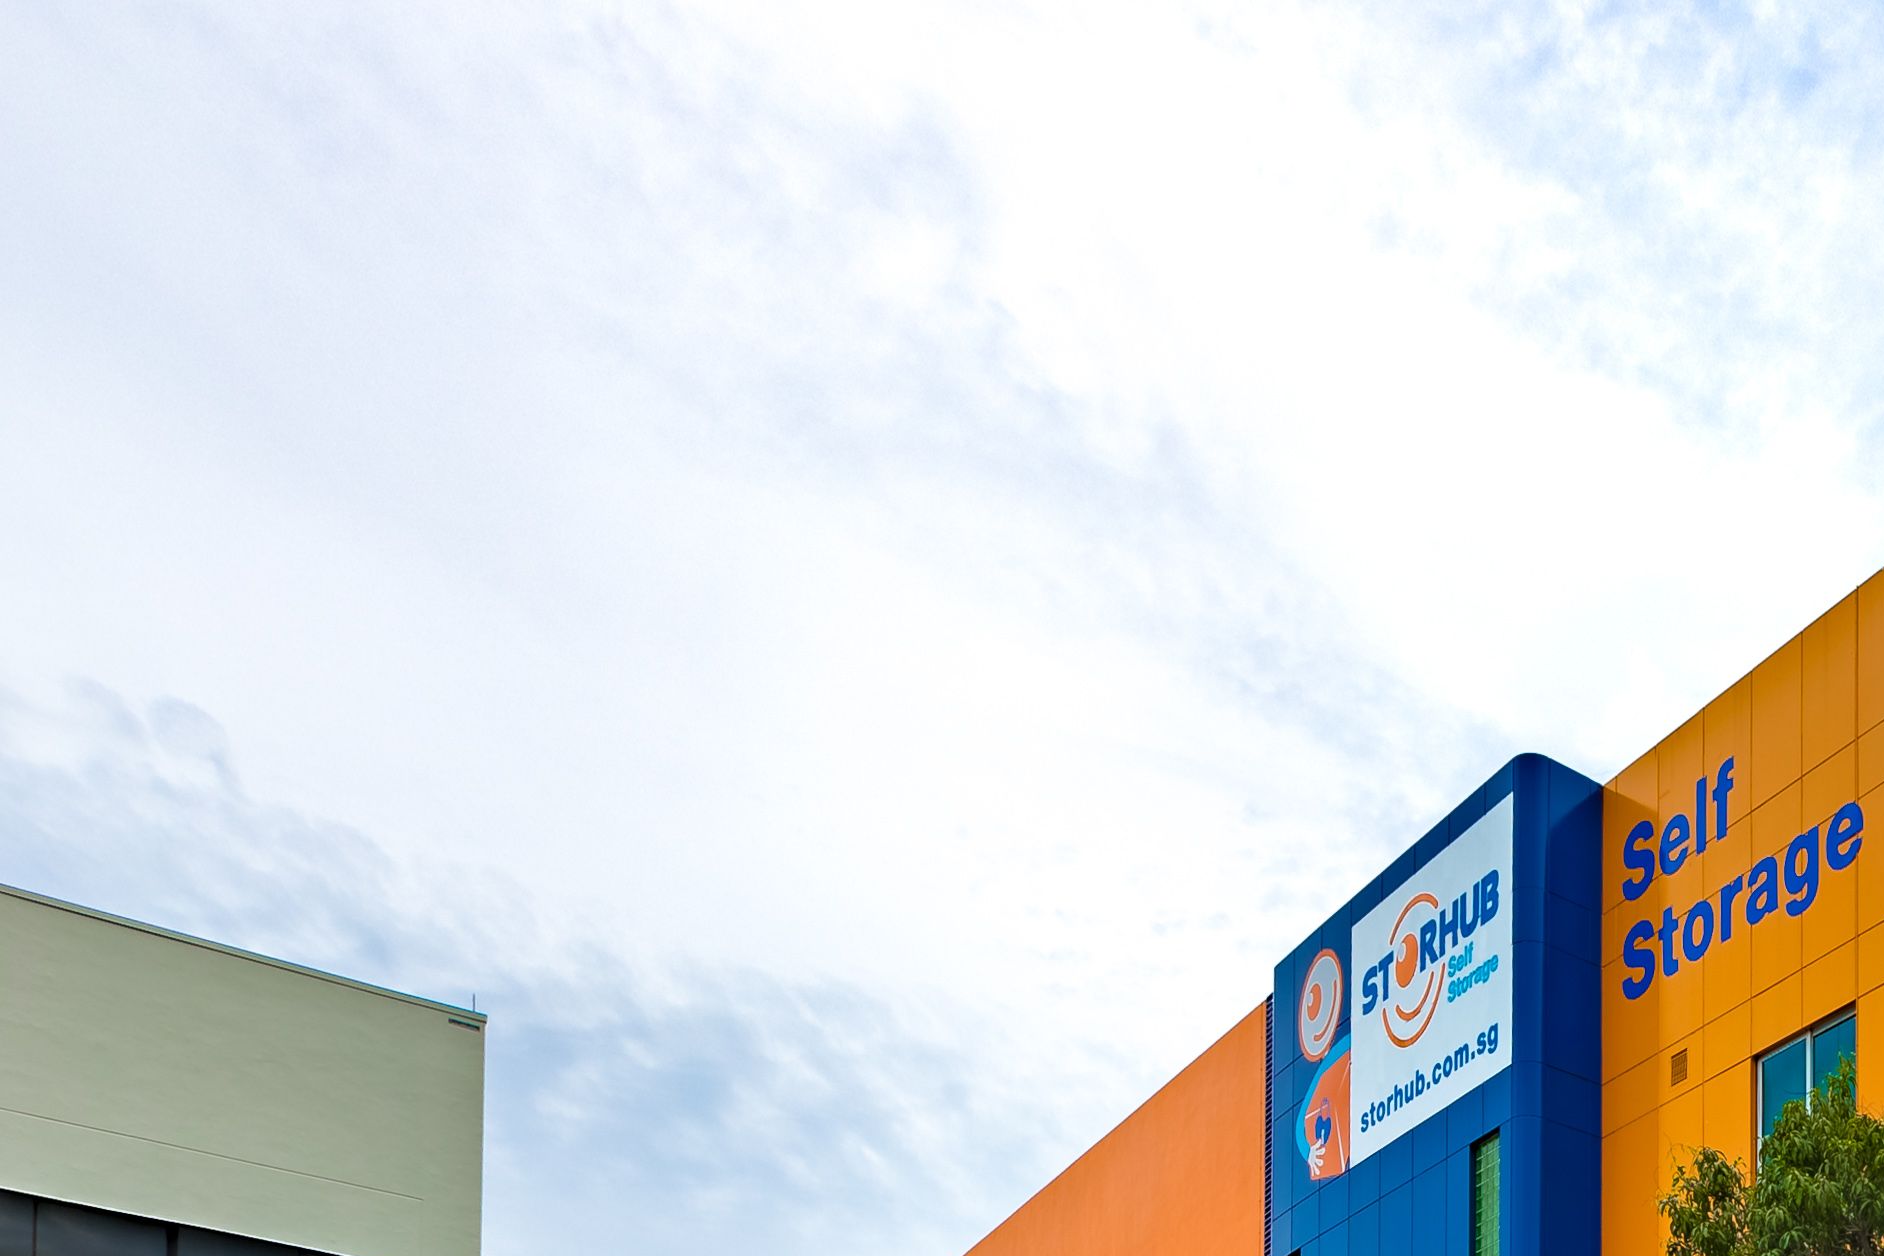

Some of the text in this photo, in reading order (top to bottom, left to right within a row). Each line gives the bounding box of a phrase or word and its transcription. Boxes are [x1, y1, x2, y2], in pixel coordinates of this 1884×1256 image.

[1621, 755, 1735, 902] Self
[1361, 869, 1499, 1016] STORHUB
[1447, 941, 1474, 978] Self
[1620, 801, 1865, 1001] Storage
[1447, 954, 1499, 1004] Storage
[1360, 1022, 1499, 1133] storhub.com.sg
